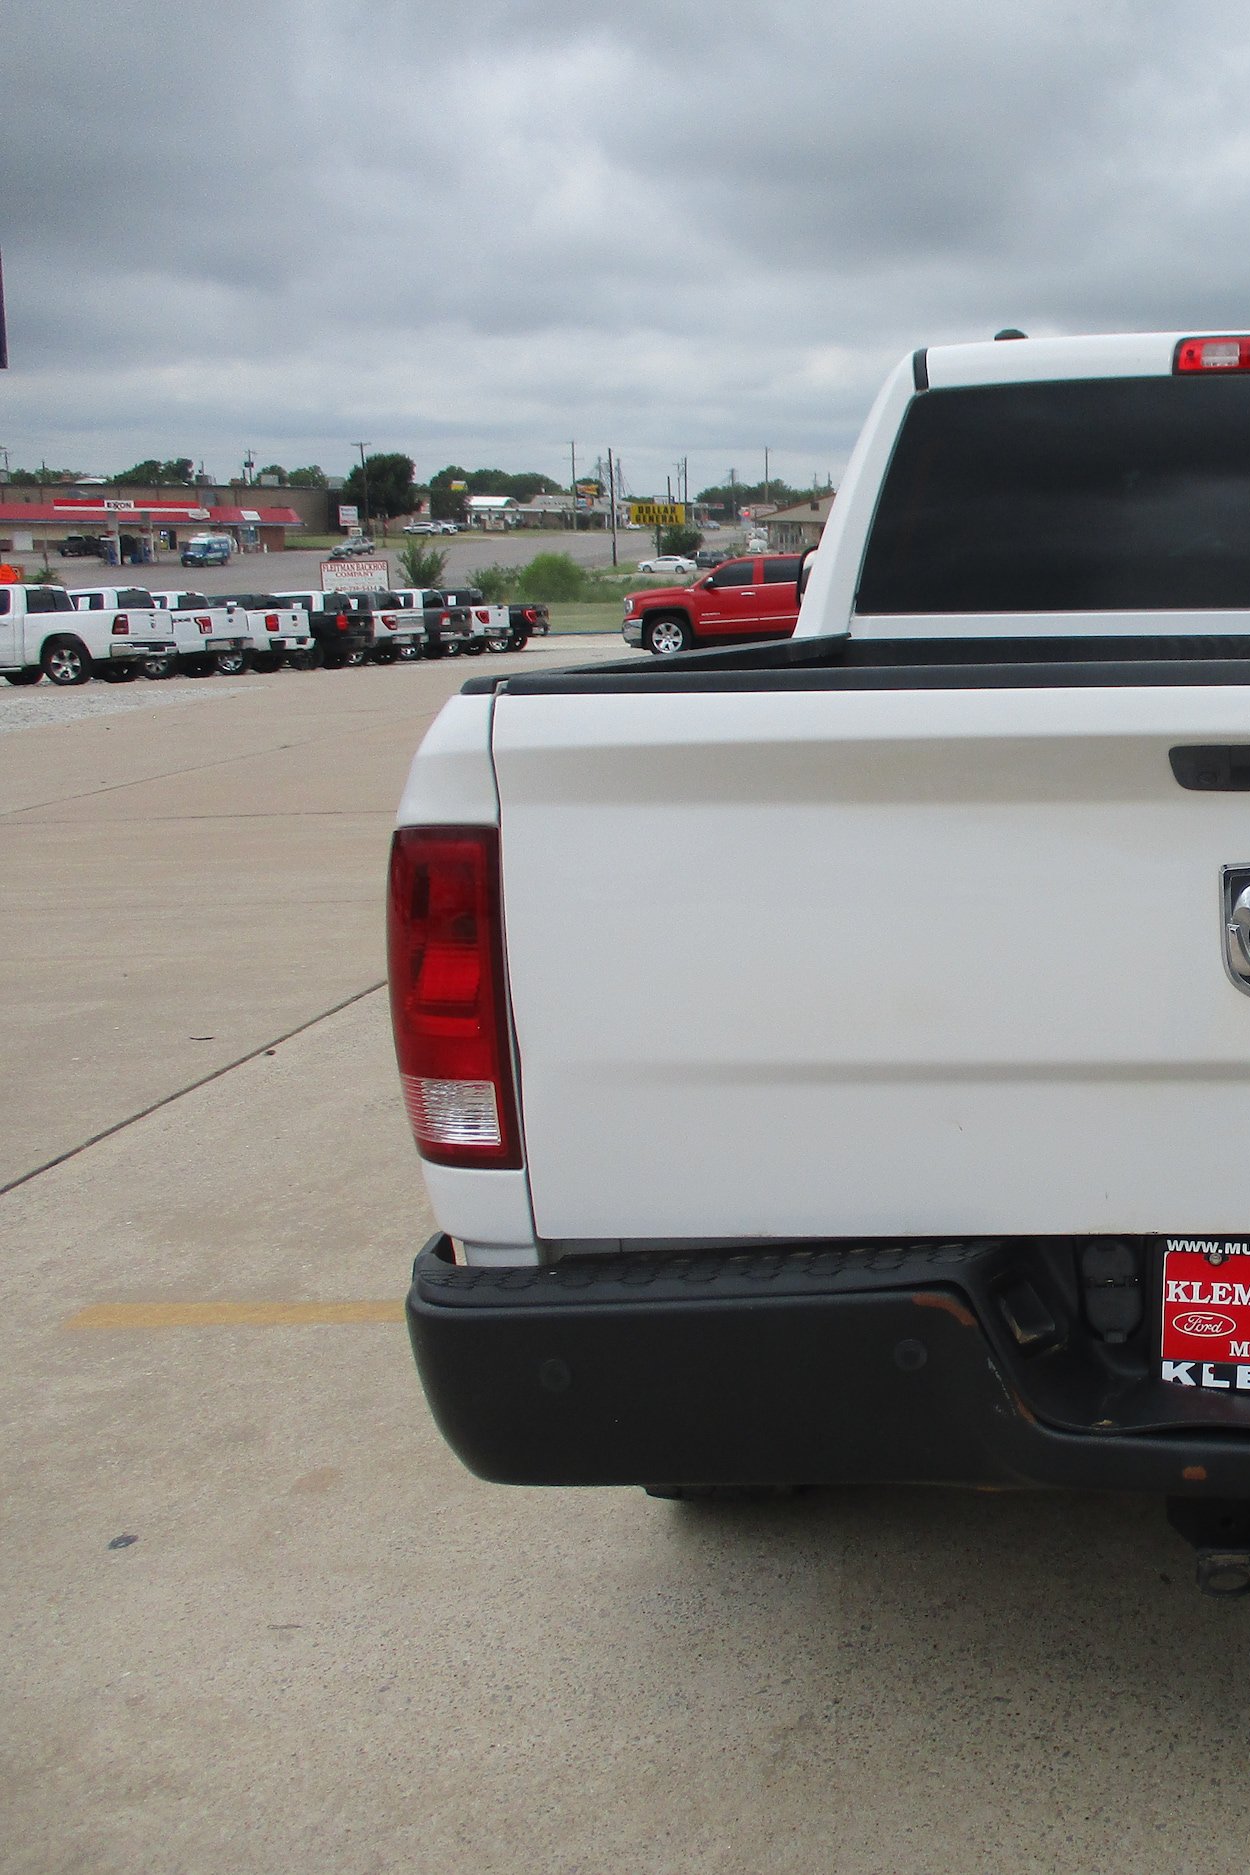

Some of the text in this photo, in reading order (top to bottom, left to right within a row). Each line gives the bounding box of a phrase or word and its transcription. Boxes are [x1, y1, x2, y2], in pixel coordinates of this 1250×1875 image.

[638, 505, 675, 514] DOLLAR
[635, 514, 679, 523] GENERAL
[323, 562, 386, 572] FLEITMAN BACKHOE
[1181, 1314, 1225, 1335] Ford
